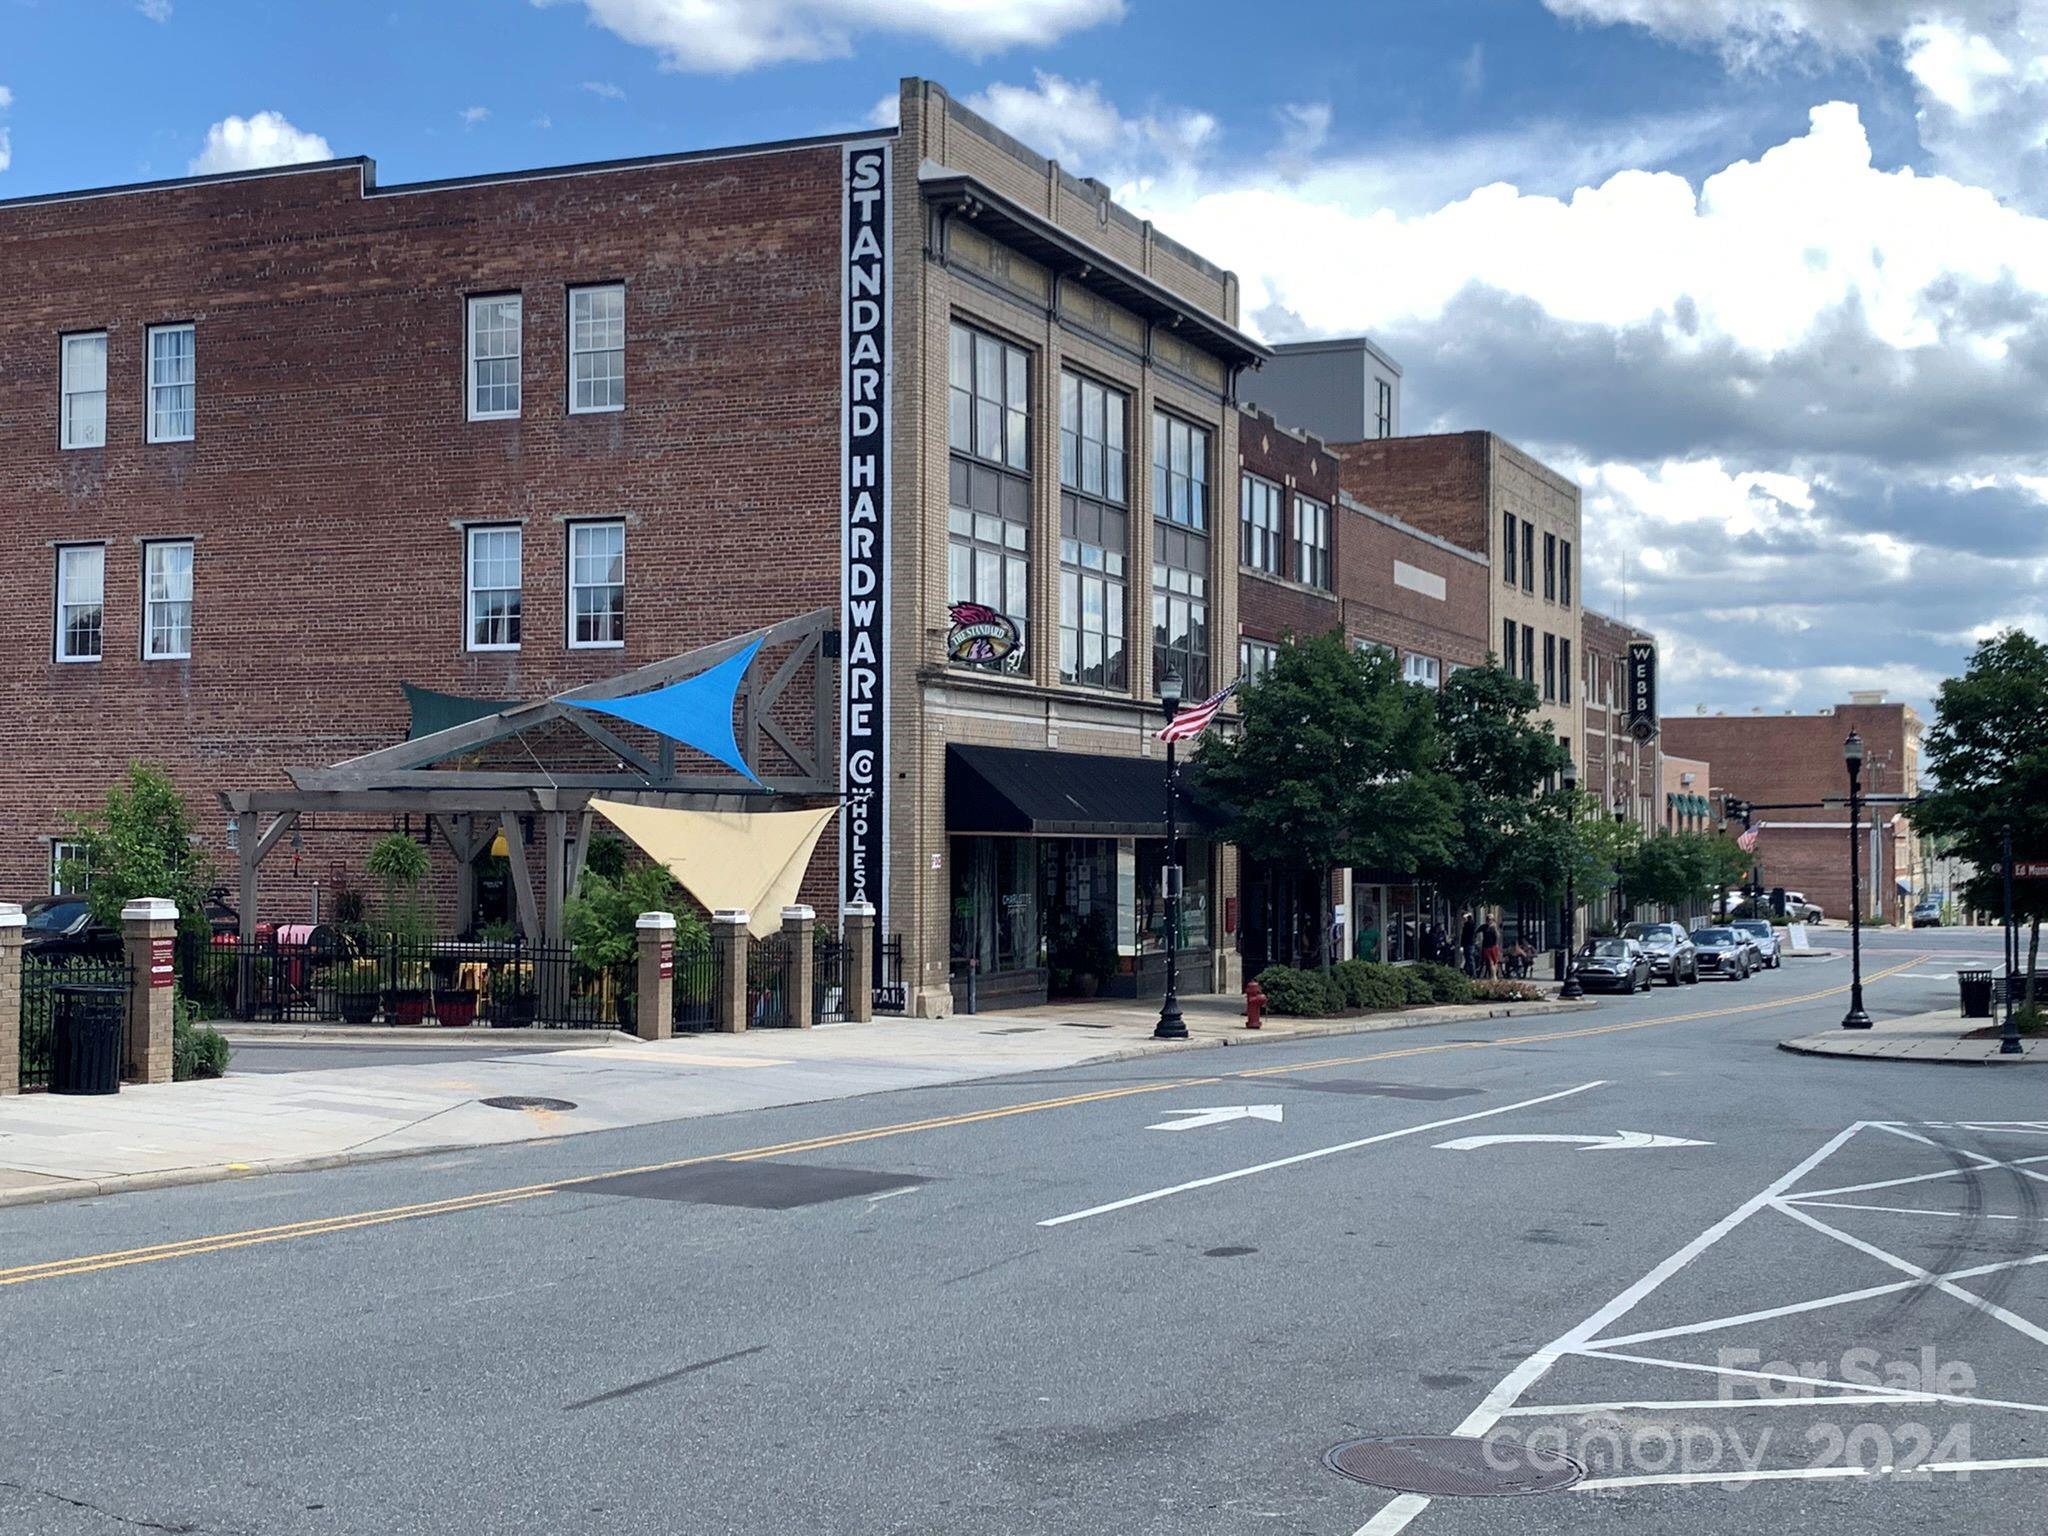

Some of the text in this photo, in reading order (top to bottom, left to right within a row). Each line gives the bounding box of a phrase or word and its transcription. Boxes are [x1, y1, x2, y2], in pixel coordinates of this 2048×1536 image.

[851, 155, 883, 437] STANDARD
[850, 455, 877, 736] HARDWARE
[951, 624, 1005, 646] THE STANDARD
[1633, 647, 1650, 712] WEBB
[851, 787, 869, 903] WHOLESA
